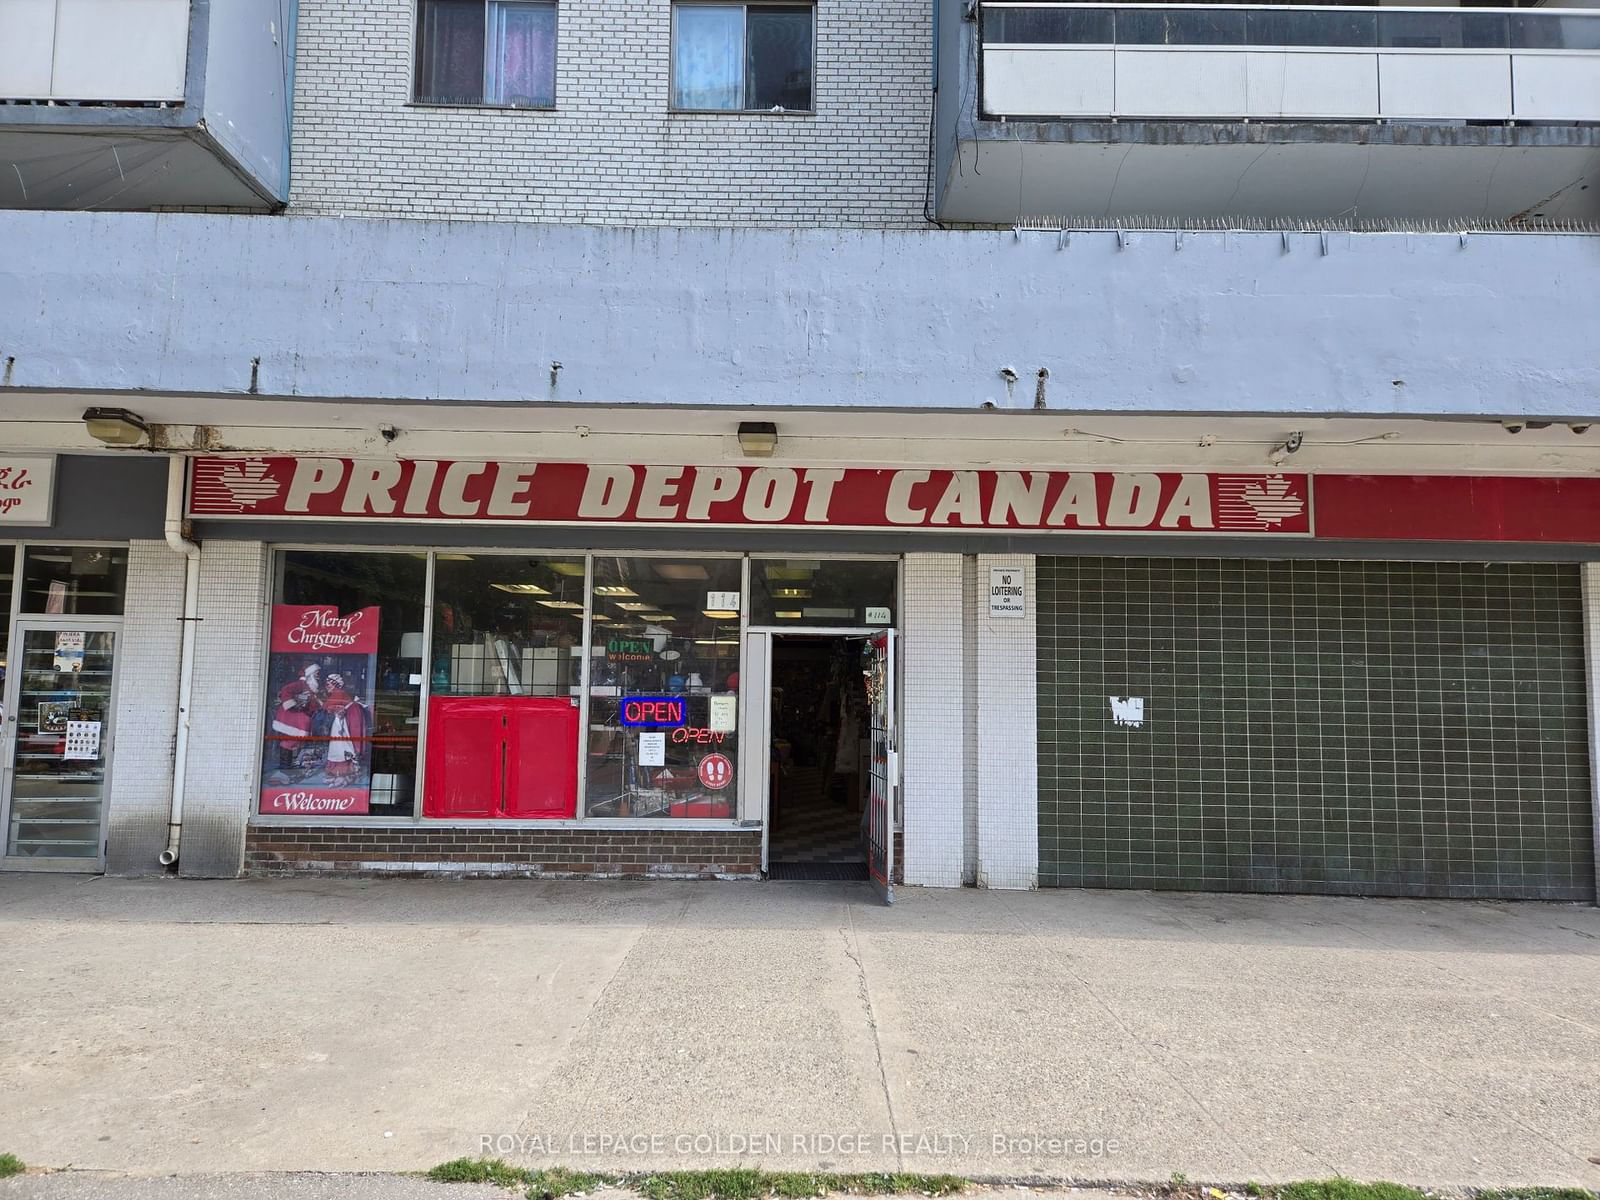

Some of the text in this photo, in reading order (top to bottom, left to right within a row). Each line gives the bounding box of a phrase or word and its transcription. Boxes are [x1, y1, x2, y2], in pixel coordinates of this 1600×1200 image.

[284, 457, 1215, 528] PRICE DEPOT CANADA
[1002, 575, 1012, 585] NO
[991, 586, 1023, 597] LOITERING
[300, 609, 363, 633] Merry
[288, 627, 361, 650] Christmas
[608, 640, 650, 653] OPEN
[625, 702, 682, 722] OPEN
[672, 727, 725, 744] OPEN
[274, 792, 355, 810] Welcome
